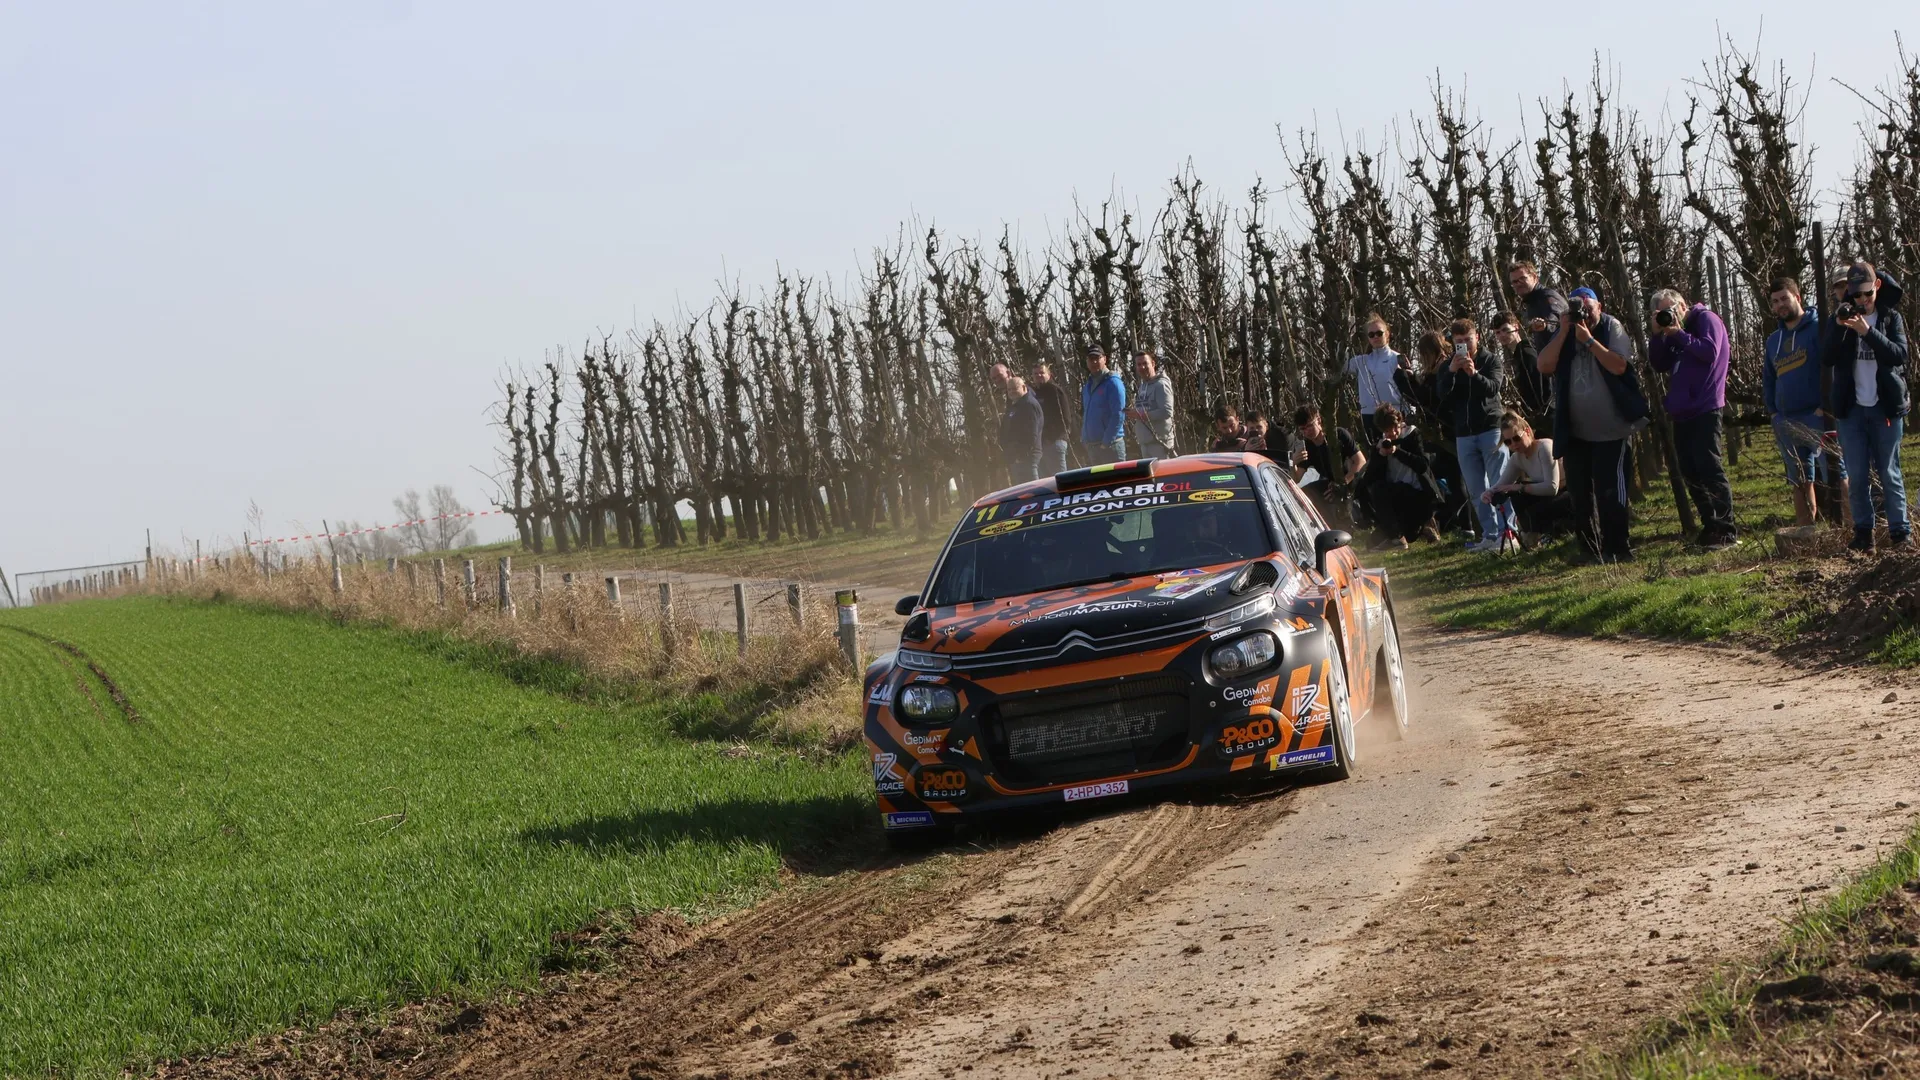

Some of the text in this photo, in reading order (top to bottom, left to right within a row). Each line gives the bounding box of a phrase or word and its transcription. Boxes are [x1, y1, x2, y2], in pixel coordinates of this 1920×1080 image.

[975, 504, 1000, 523] 11
[1041, 496, 1169, 522] KROON-OIL
[1220, 719, 1274, 747] P&CO
[1225, 737, 1275, 754] GROUP
[1288, 751, 1326, 763] MICHELIN
[924, 789, 966, 797] GROUP
[1067, 782, 1126, 800] 2-HPD-352
[897, 816, 927, 824] MICHELIN
